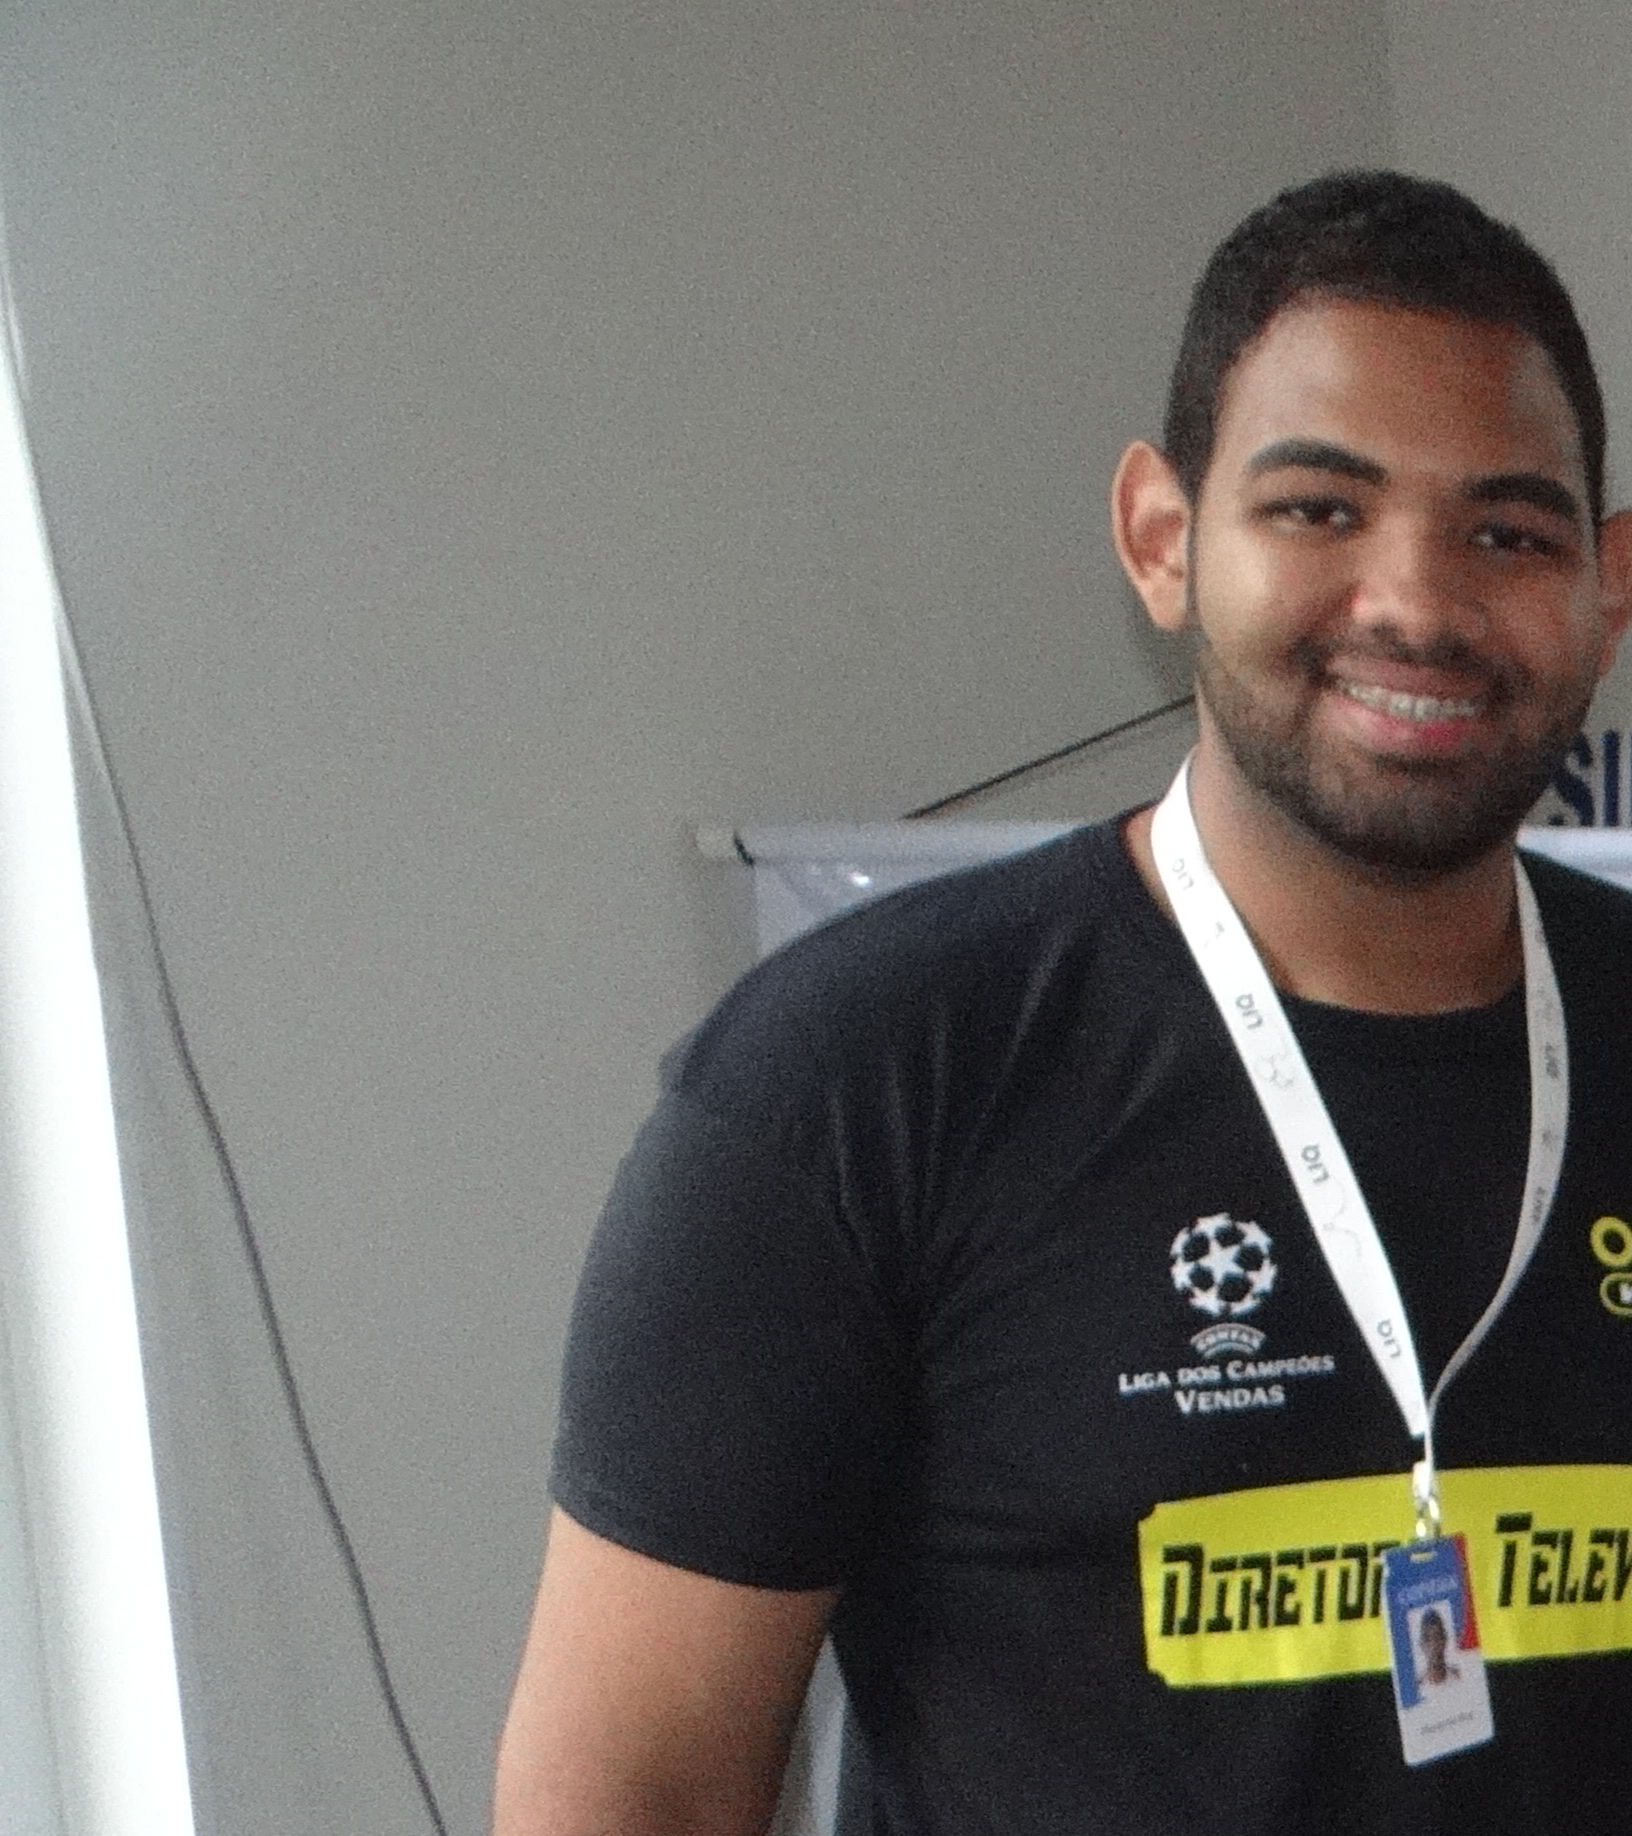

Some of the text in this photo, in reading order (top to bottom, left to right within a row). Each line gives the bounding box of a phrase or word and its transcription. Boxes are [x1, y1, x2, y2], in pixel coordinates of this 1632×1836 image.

[1118, 1354, 1336, 1395] LIGA DOS CAMPEÕES
[1174, 1384, 1286, 1415] VENDAS
